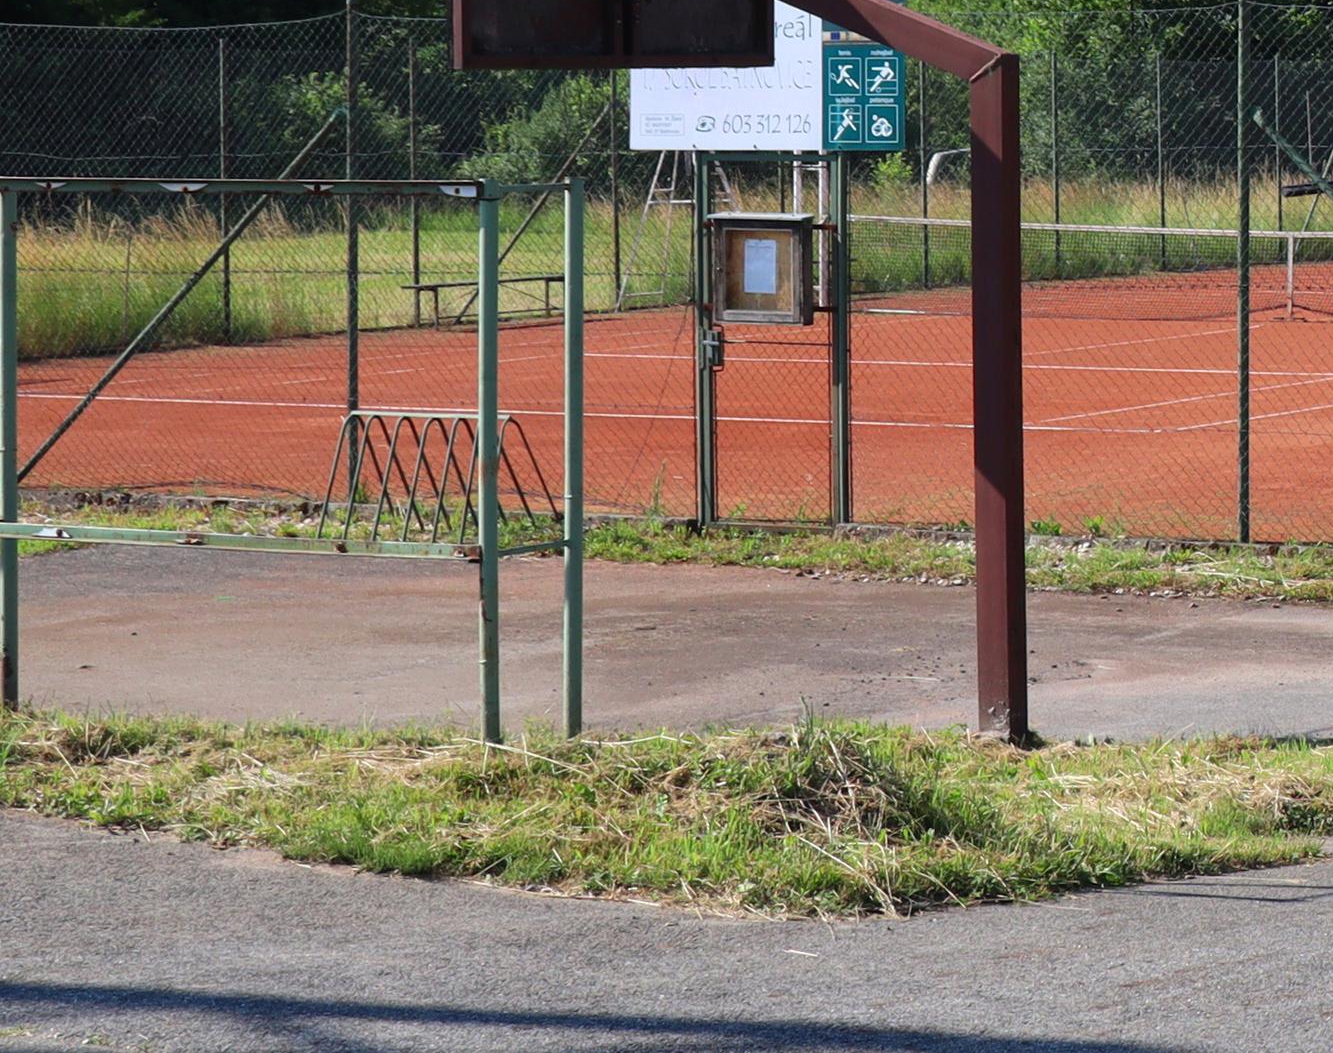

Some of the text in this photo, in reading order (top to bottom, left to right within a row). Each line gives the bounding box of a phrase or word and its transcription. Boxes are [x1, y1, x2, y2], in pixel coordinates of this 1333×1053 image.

[722, 114, 812, 134] 603 312 126
